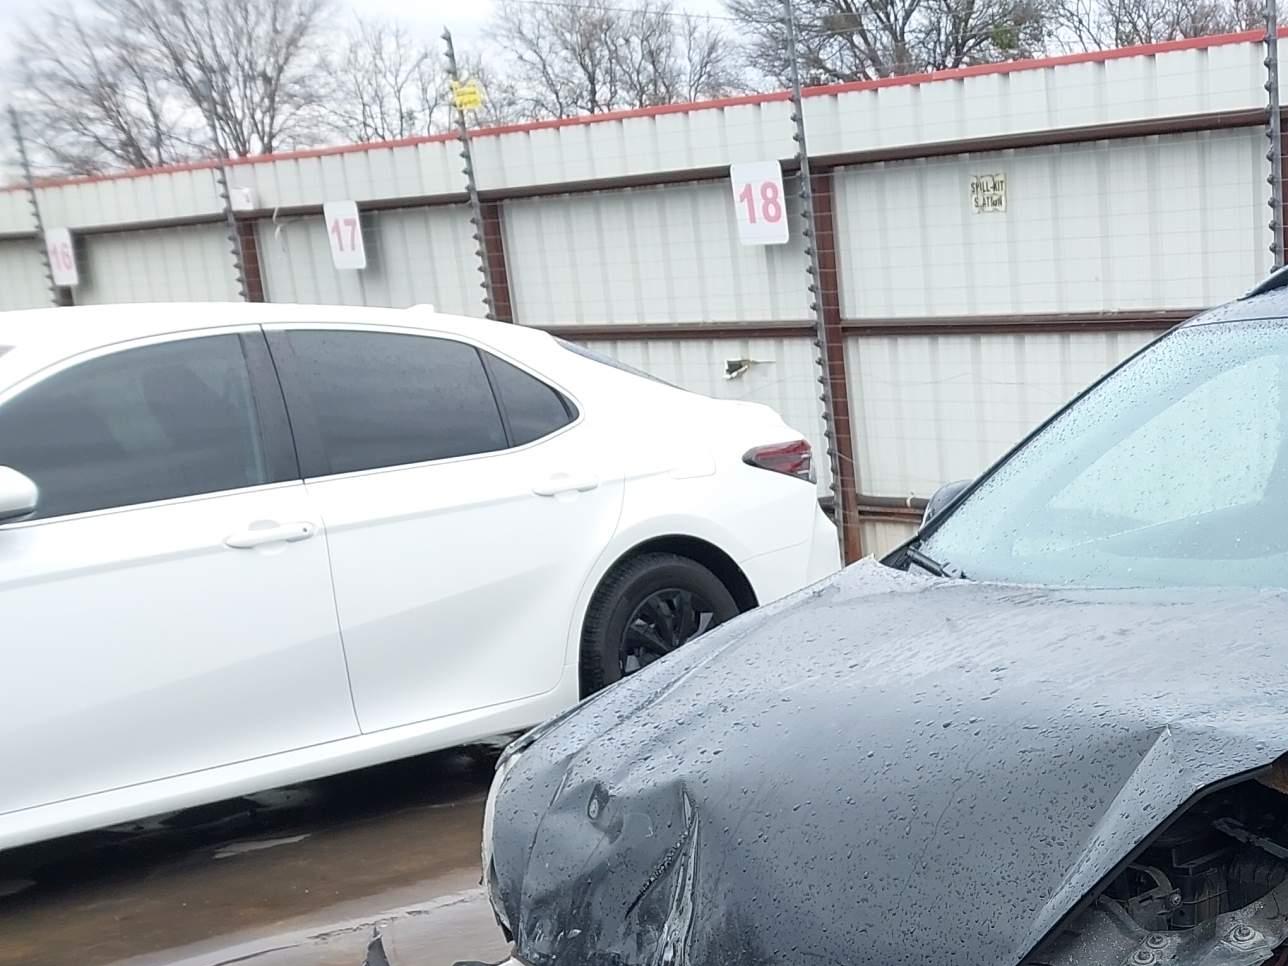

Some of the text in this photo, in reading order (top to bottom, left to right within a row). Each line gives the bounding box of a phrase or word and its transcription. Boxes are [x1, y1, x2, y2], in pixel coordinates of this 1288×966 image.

[739, 181, 782, 224] 18
[974, 195, 1003, 208] SATION
[331, 218, 357, 251] 17
